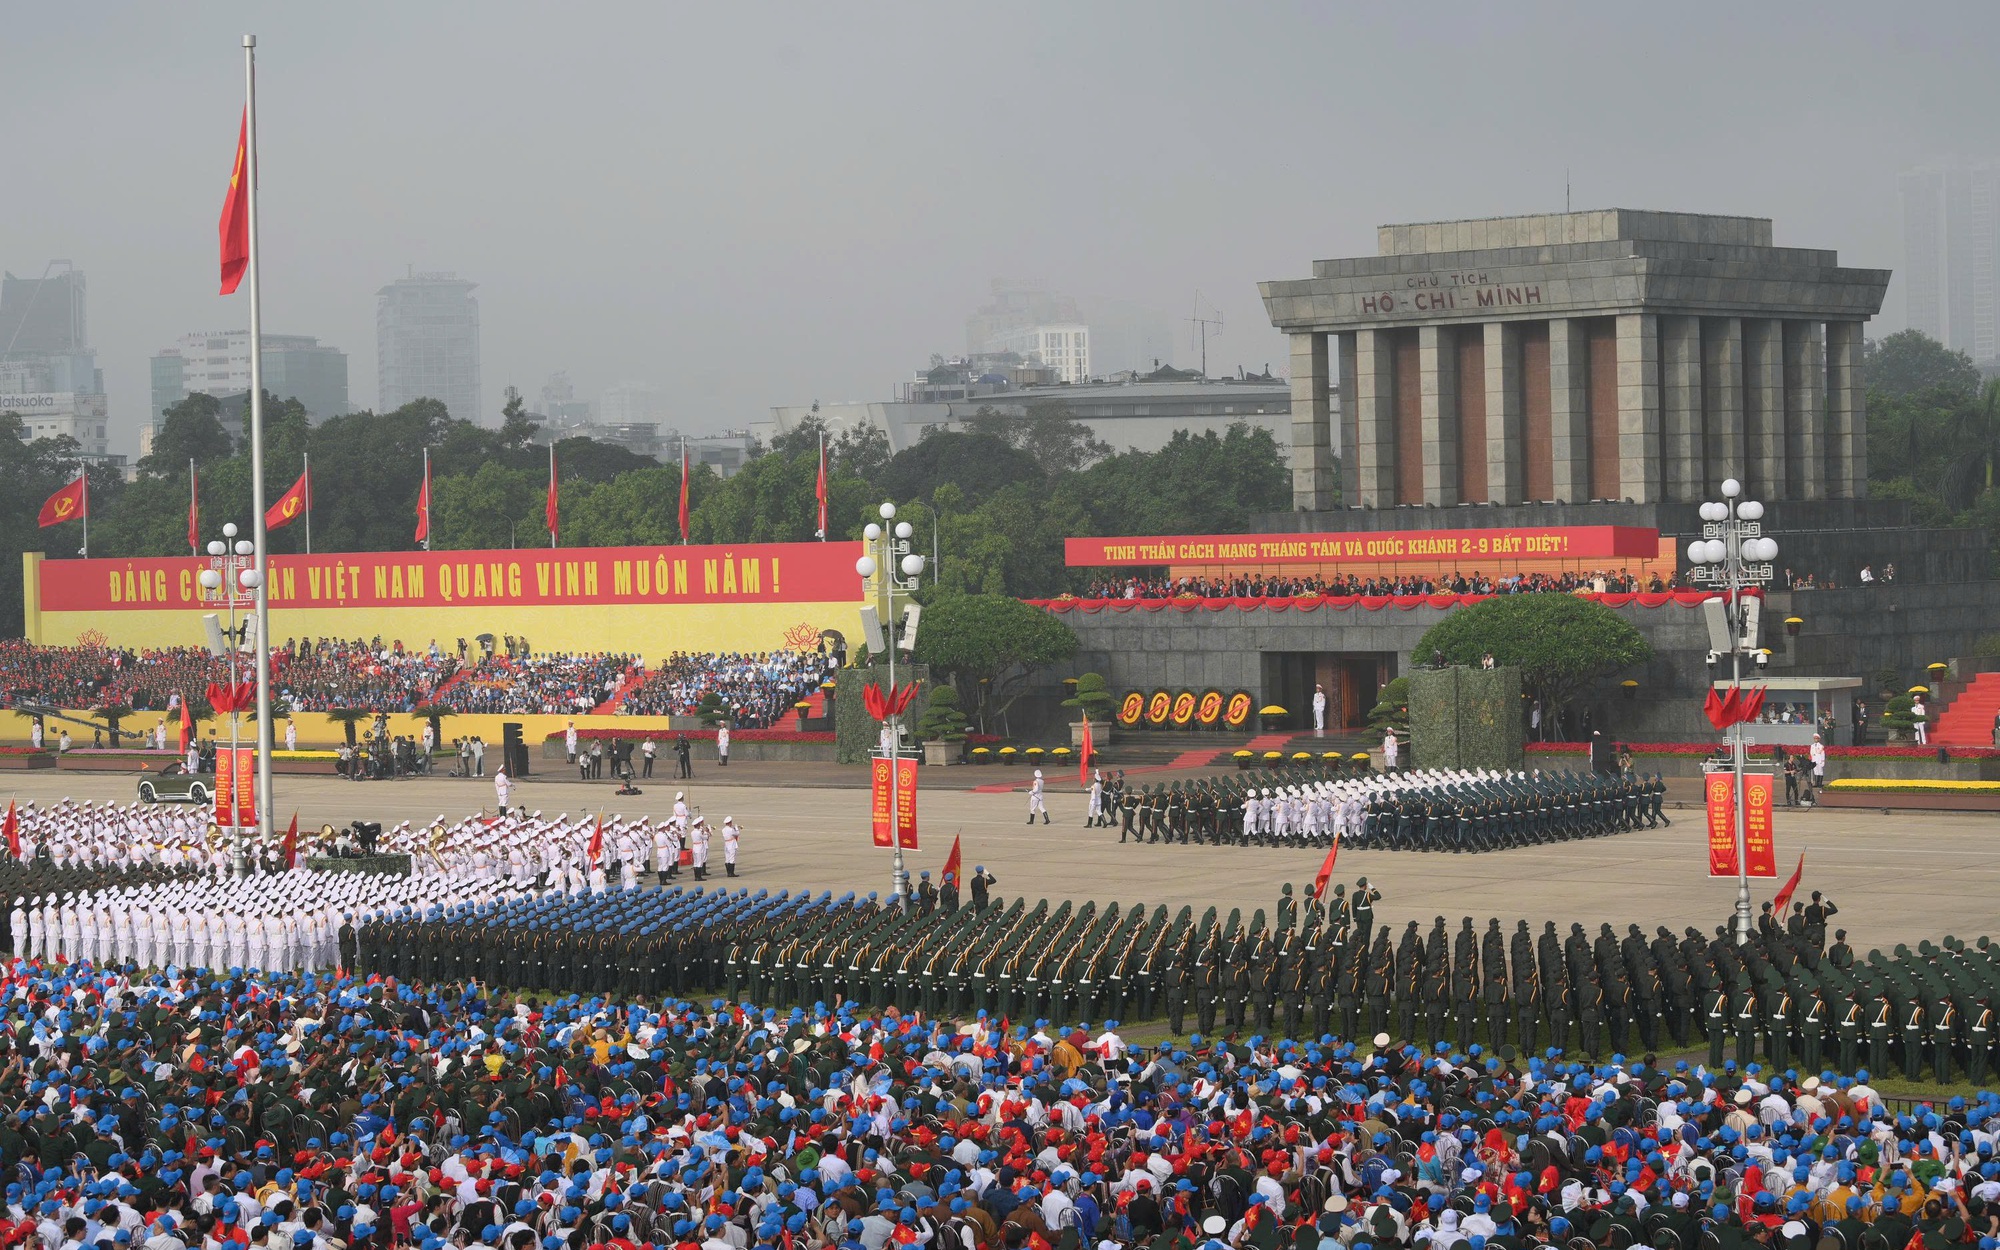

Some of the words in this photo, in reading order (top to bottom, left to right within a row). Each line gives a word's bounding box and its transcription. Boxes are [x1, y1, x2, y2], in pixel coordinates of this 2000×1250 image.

[0, 395, 54, 408] atsuoka
[1103, 545, 1136, 560] TINH
[1139, 540, 1175, 560] THẦN
[1179, 541, 1214, 559] CÁCH
[1218, 543, 1257, 561] MẠNG
[1260, 539, 1307, 558] THÁNG
[1310, 538, 1341, 557] TÁM
[1345, 537, 1364, 556] VÀ
[1367, 536, 1404, 557] QUỐC
[1407, 535, 1457, 555] KHÁNH
[1492, 533, 1522, 553] BẤT
[109, 562, 167, 602] ĐẢNG
[267, 560, 295, 600] ẢN
[308, 560, 360, 606] VIỆT
[374, 565, 424, 599] NAM
[439, 562, 522, 602] QUANG
[535, 561, 598, 597] VINH
[613, 553, 688, 596] MUÔN
[704, 552, 761, 594] NĂM
